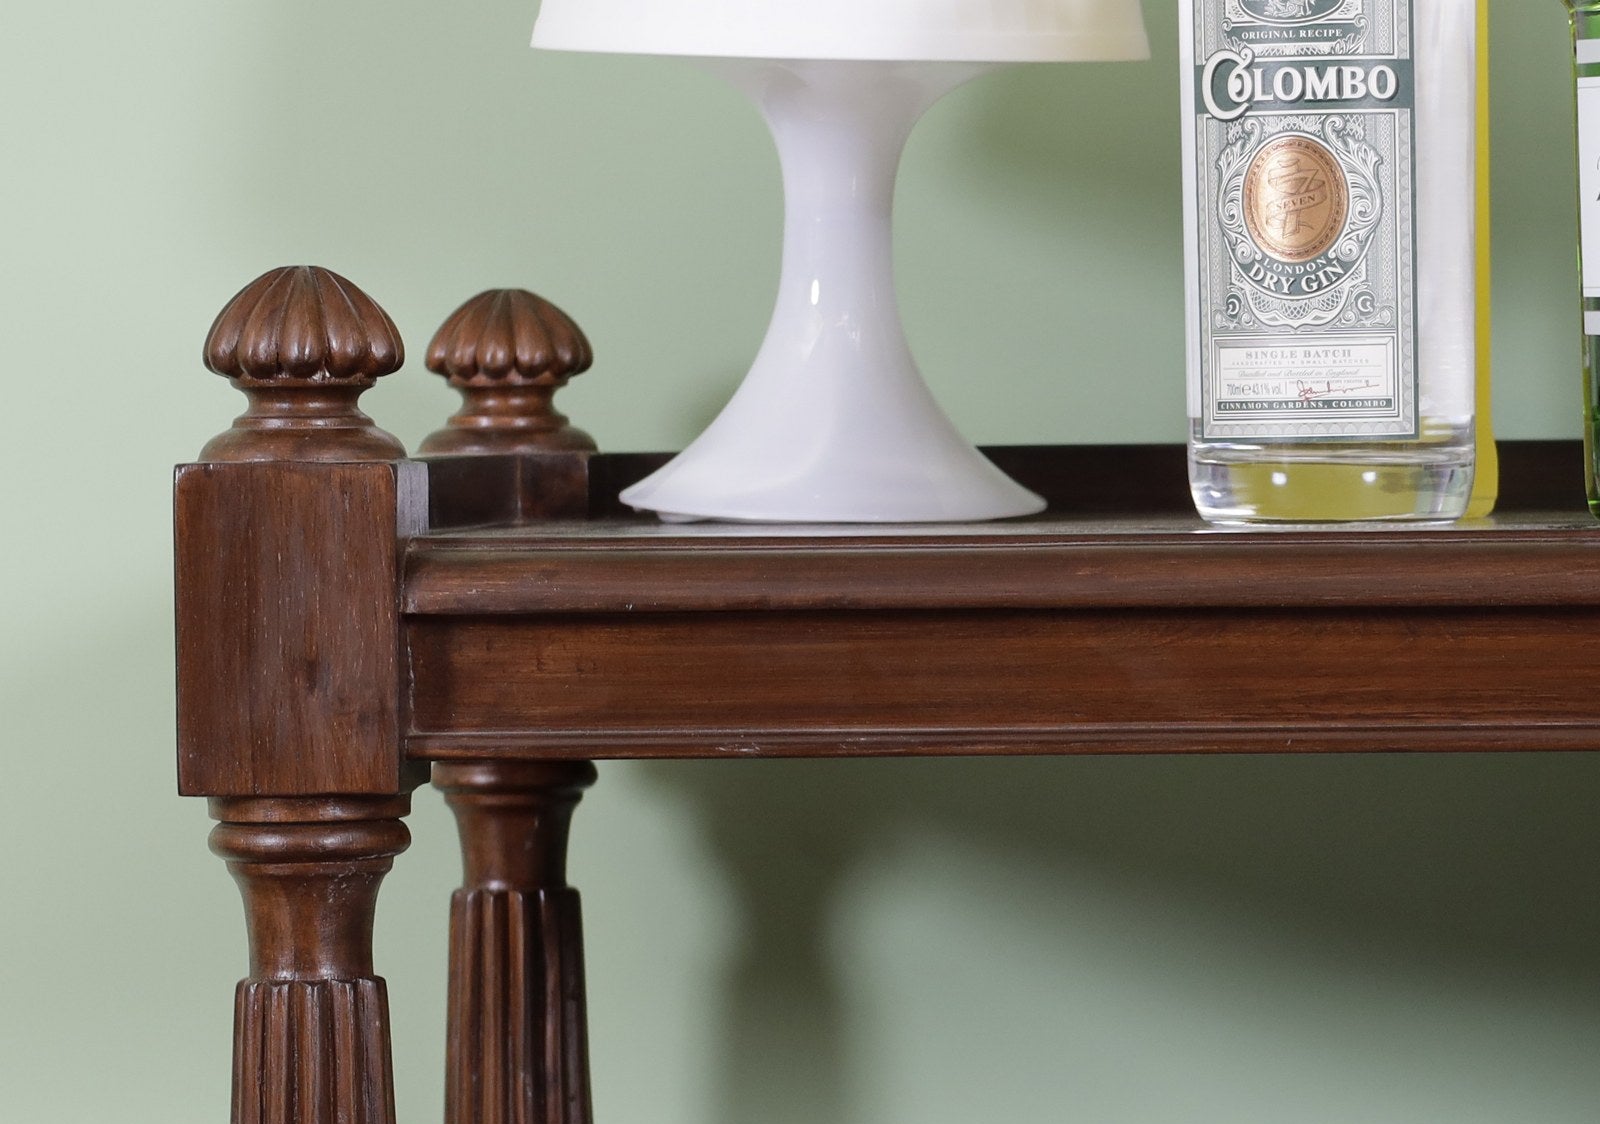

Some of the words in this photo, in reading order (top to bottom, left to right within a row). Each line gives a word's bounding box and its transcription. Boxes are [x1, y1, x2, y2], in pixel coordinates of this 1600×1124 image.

[1241, 29, 1297, 40] ORIGINAL
[1299, 28, 1343, 38] RECIPE
[1201, 48, 1398, 120] COLOMBO
[1276, 193, 1316, 210] SEVEN
[1263, 256, 1328, 275] LONDON
[1249, 264, 1294, 296] DRY
[1301, 260, 1345, 293] GIN
[1245, 349, 1298, 361] SINGLE
[1303, 348, 1352, 359] BATCH
[1220, 400, 1269, 410] CINNAMON
[1273, 399, 1328, 410] GARDENS,
[1332, 398, 1387, 409] COLOMBO
